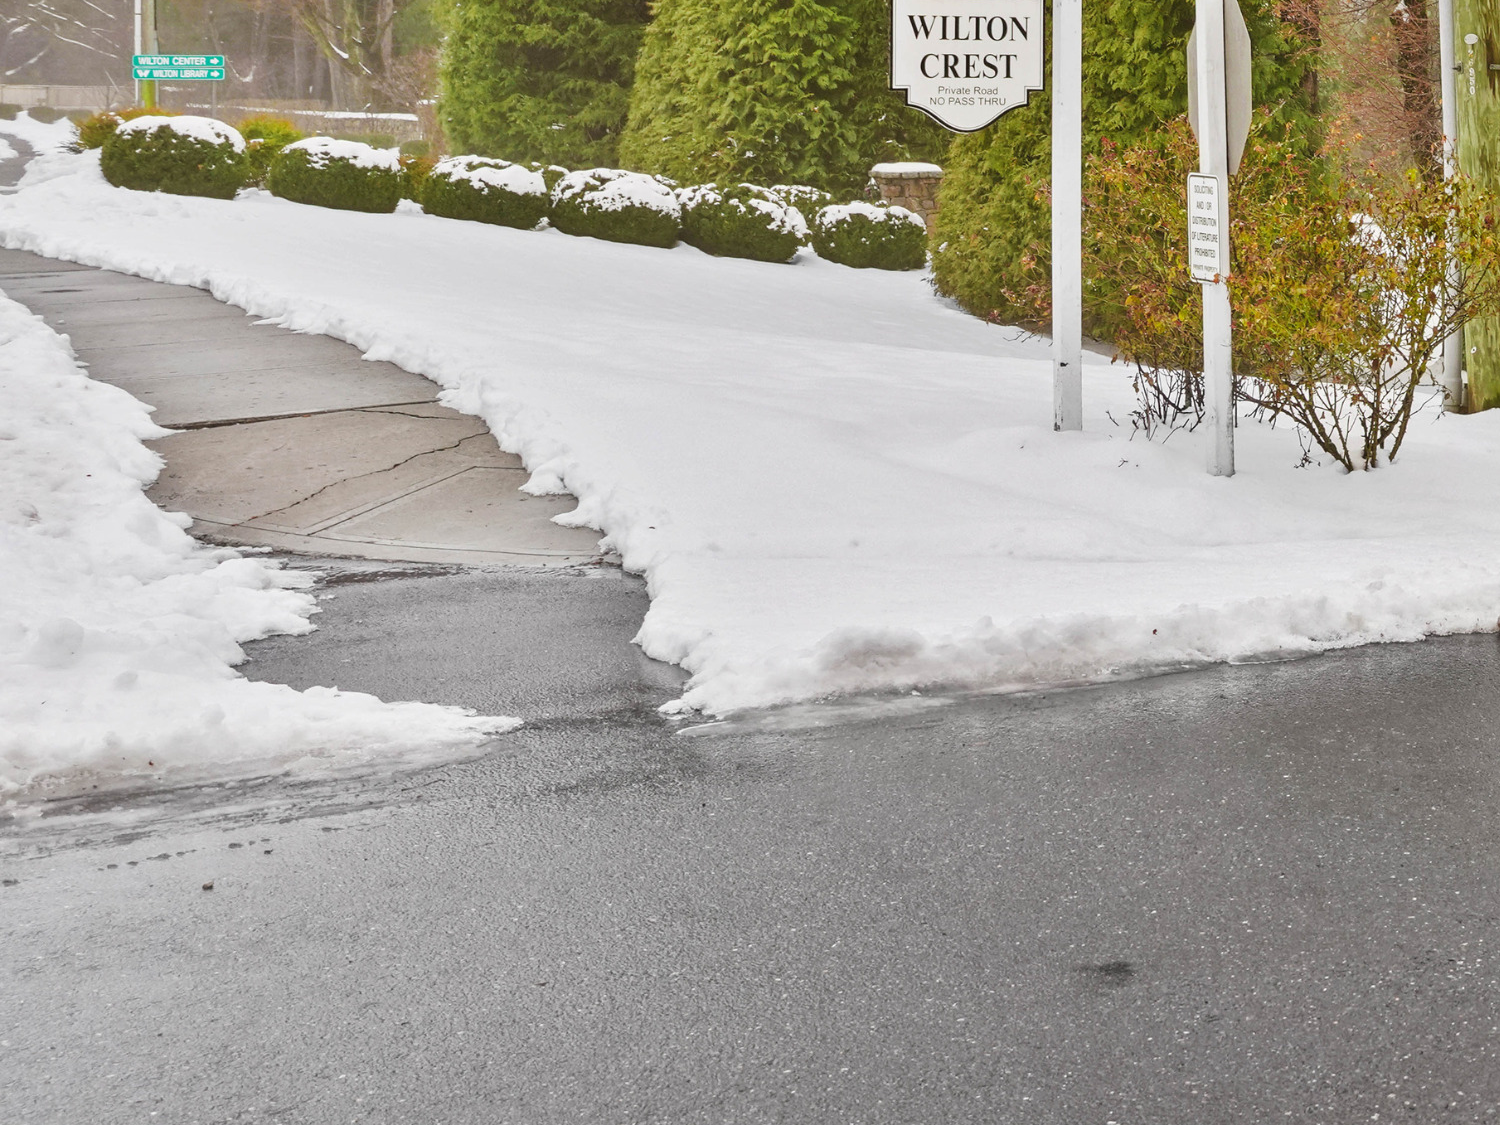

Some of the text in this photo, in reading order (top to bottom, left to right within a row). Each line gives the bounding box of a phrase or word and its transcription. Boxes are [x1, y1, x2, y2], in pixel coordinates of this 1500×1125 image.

[907, 14, 1030, 41] WILTON
[138, 57, 207, 65] WILTON CENTER
[920, 53, 1017, 79] CREST
[153, 70, 178, 78] WILTON
[180, 70, 208, 78] LIBRARY
[938, 86, 998, 95] Private Road
[929, 97, 1007, 106] NO PASS THRU
[1194, 185, 1213, 195] SOLICITING
[1196, 201, 1204, 210] AND
[1192, 215, 1217, 227] DISTRIBUTION
[1197, 231, 1218, 243] LITERATURE
[1194, 247, 1216, 259] PROHIBITED
